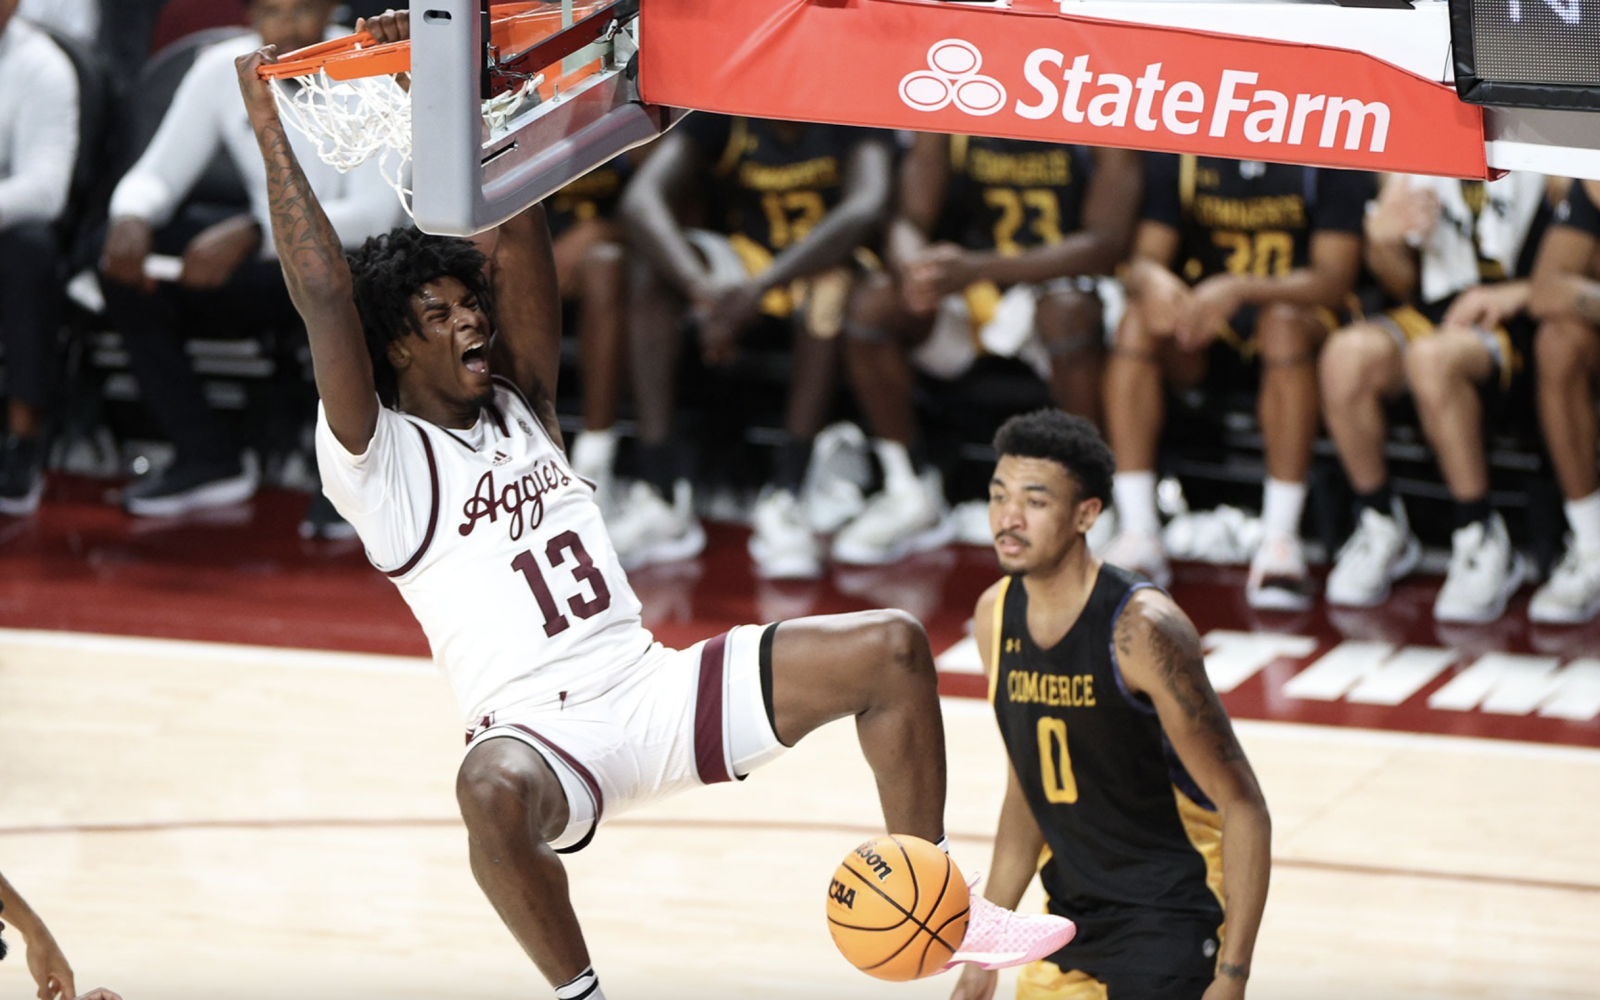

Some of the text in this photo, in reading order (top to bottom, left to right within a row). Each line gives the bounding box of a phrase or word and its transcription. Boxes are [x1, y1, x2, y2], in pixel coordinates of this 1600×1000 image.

[458, 459, 572, 541] Aggies
[510, 529, 611, 638] 13
[1037, 716, 1079, 804] 0
